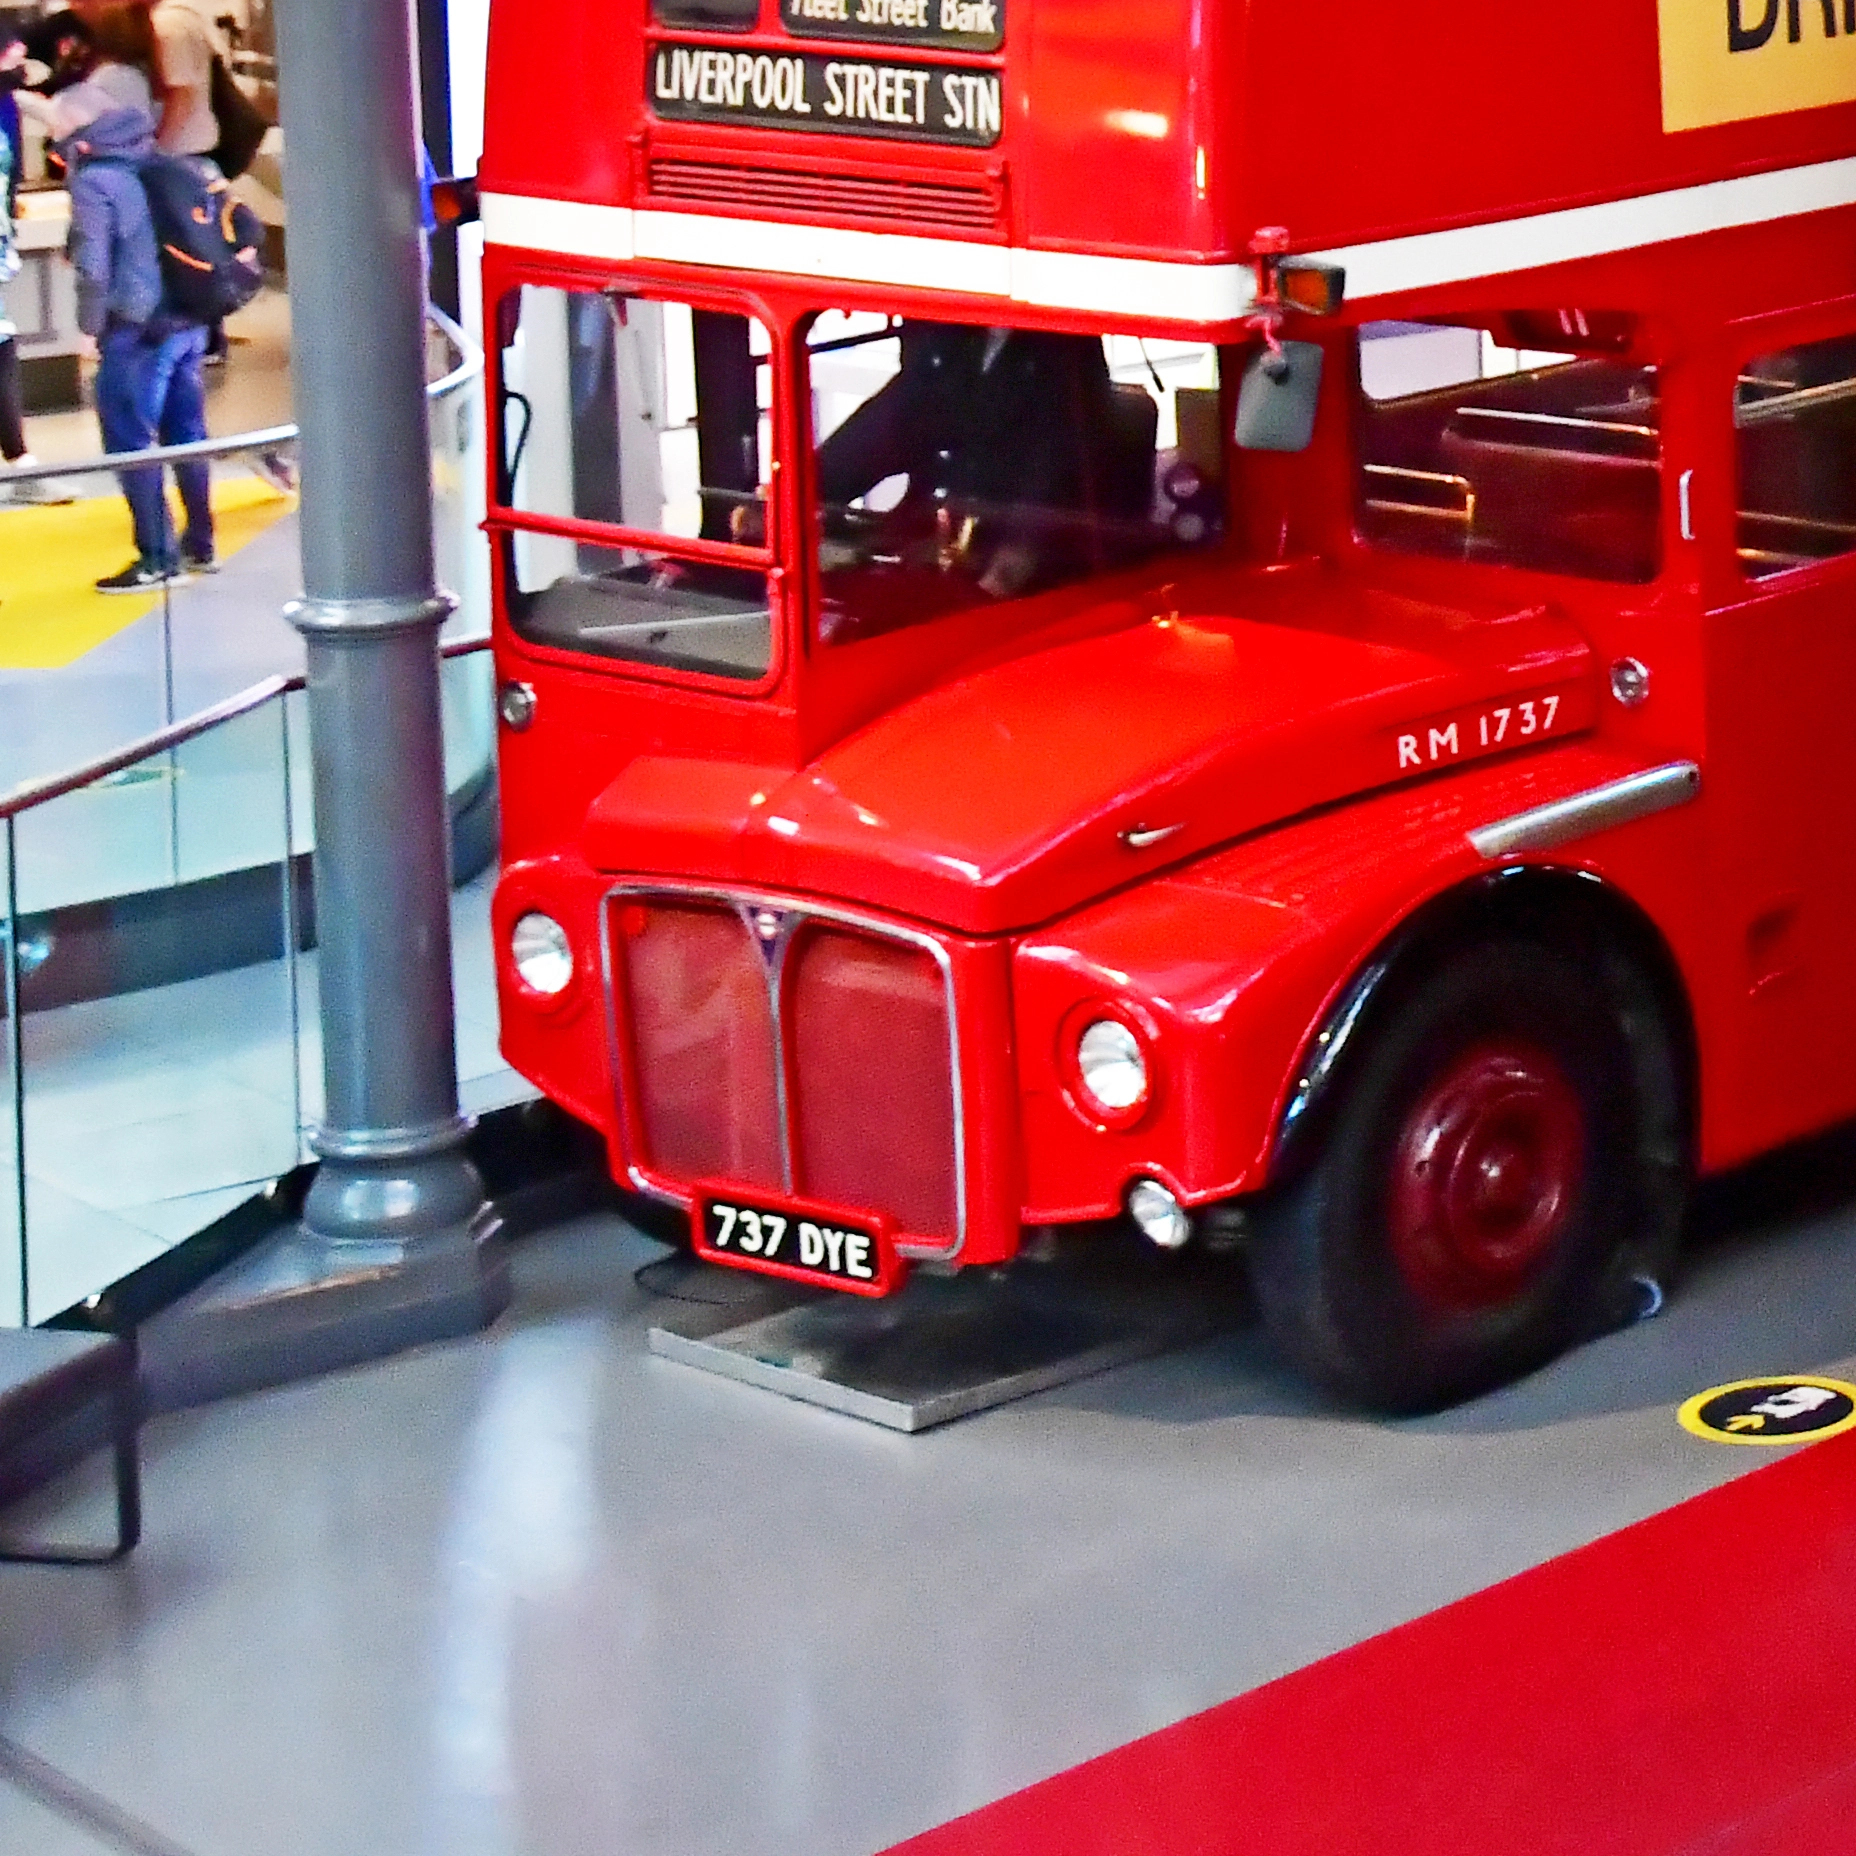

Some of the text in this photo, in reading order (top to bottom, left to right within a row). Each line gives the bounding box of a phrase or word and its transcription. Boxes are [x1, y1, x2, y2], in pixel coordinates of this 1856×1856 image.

[655, 48, 1002, 133] LIVERPOOL STREET STN
[1397, 695, 1560, 769] RM 1737
[712, 1204, 873, 1278] 737 DYE
